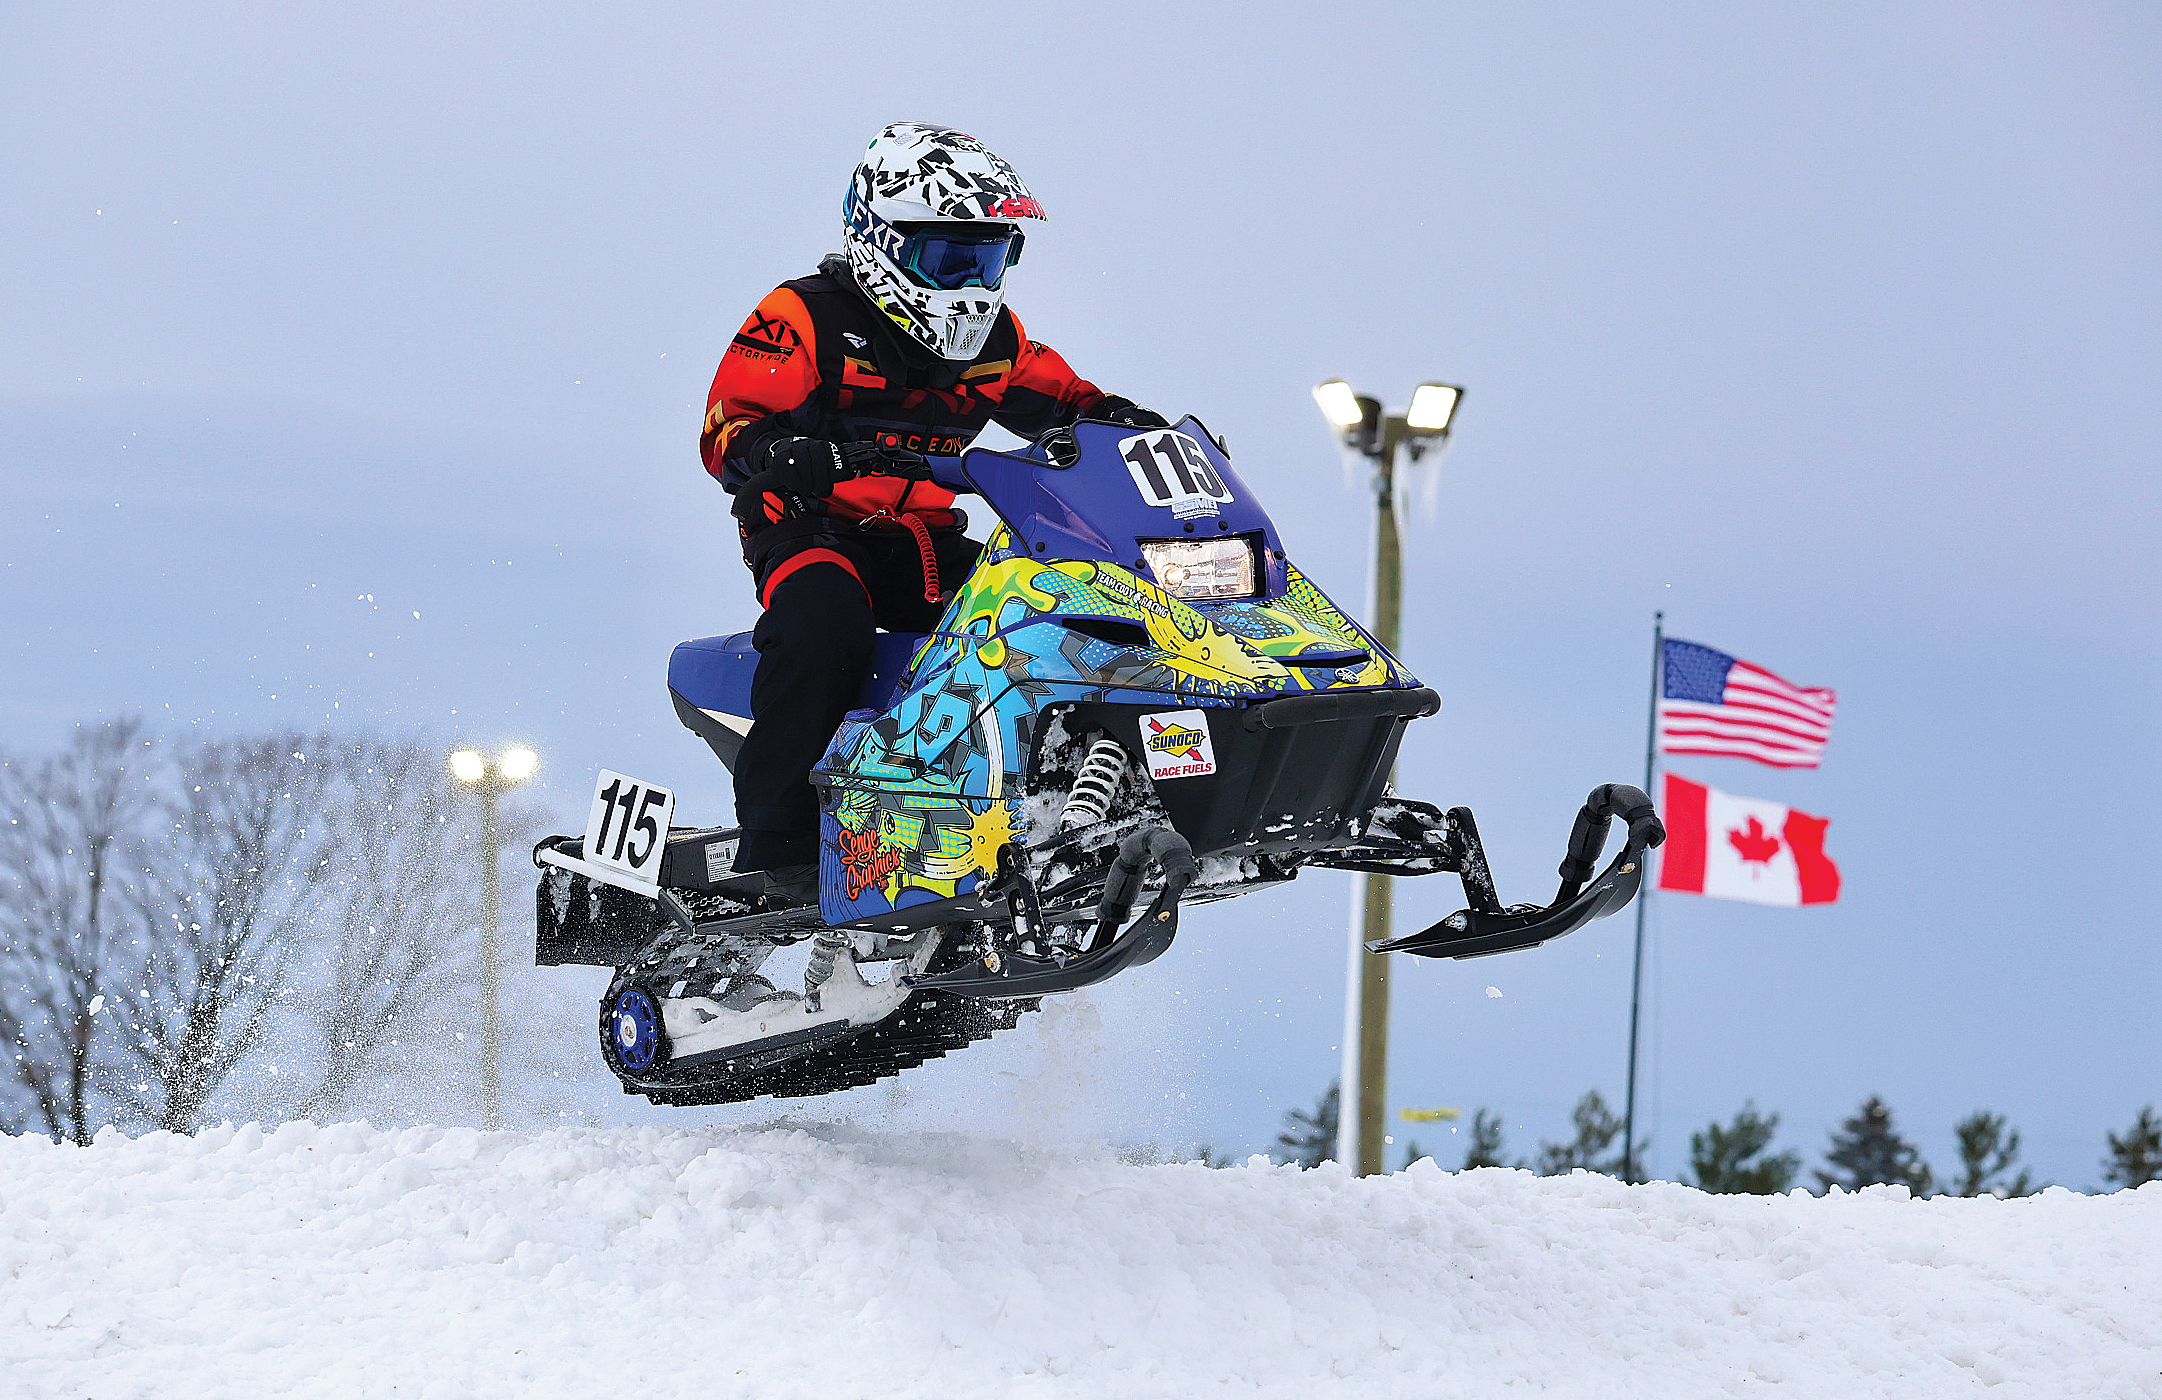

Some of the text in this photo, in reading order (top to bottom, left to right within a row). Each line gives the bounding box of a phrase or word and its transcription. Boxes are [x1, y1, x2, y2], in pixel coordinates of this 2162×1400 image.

[850, 204, 907, 261] FXR
[1125, 433, 1224, 501] 115
[1096, 570, 1169, 618] TEAM CODY RACING
[1152, 732, 1201, 750] SUNOCO
[1154, 762, 1213, 778] RACE FUELS
[595, 778, 667, 869] 115
[839, 829, 880, 865] Senge
[846, 847, 901, 900] Graphics
